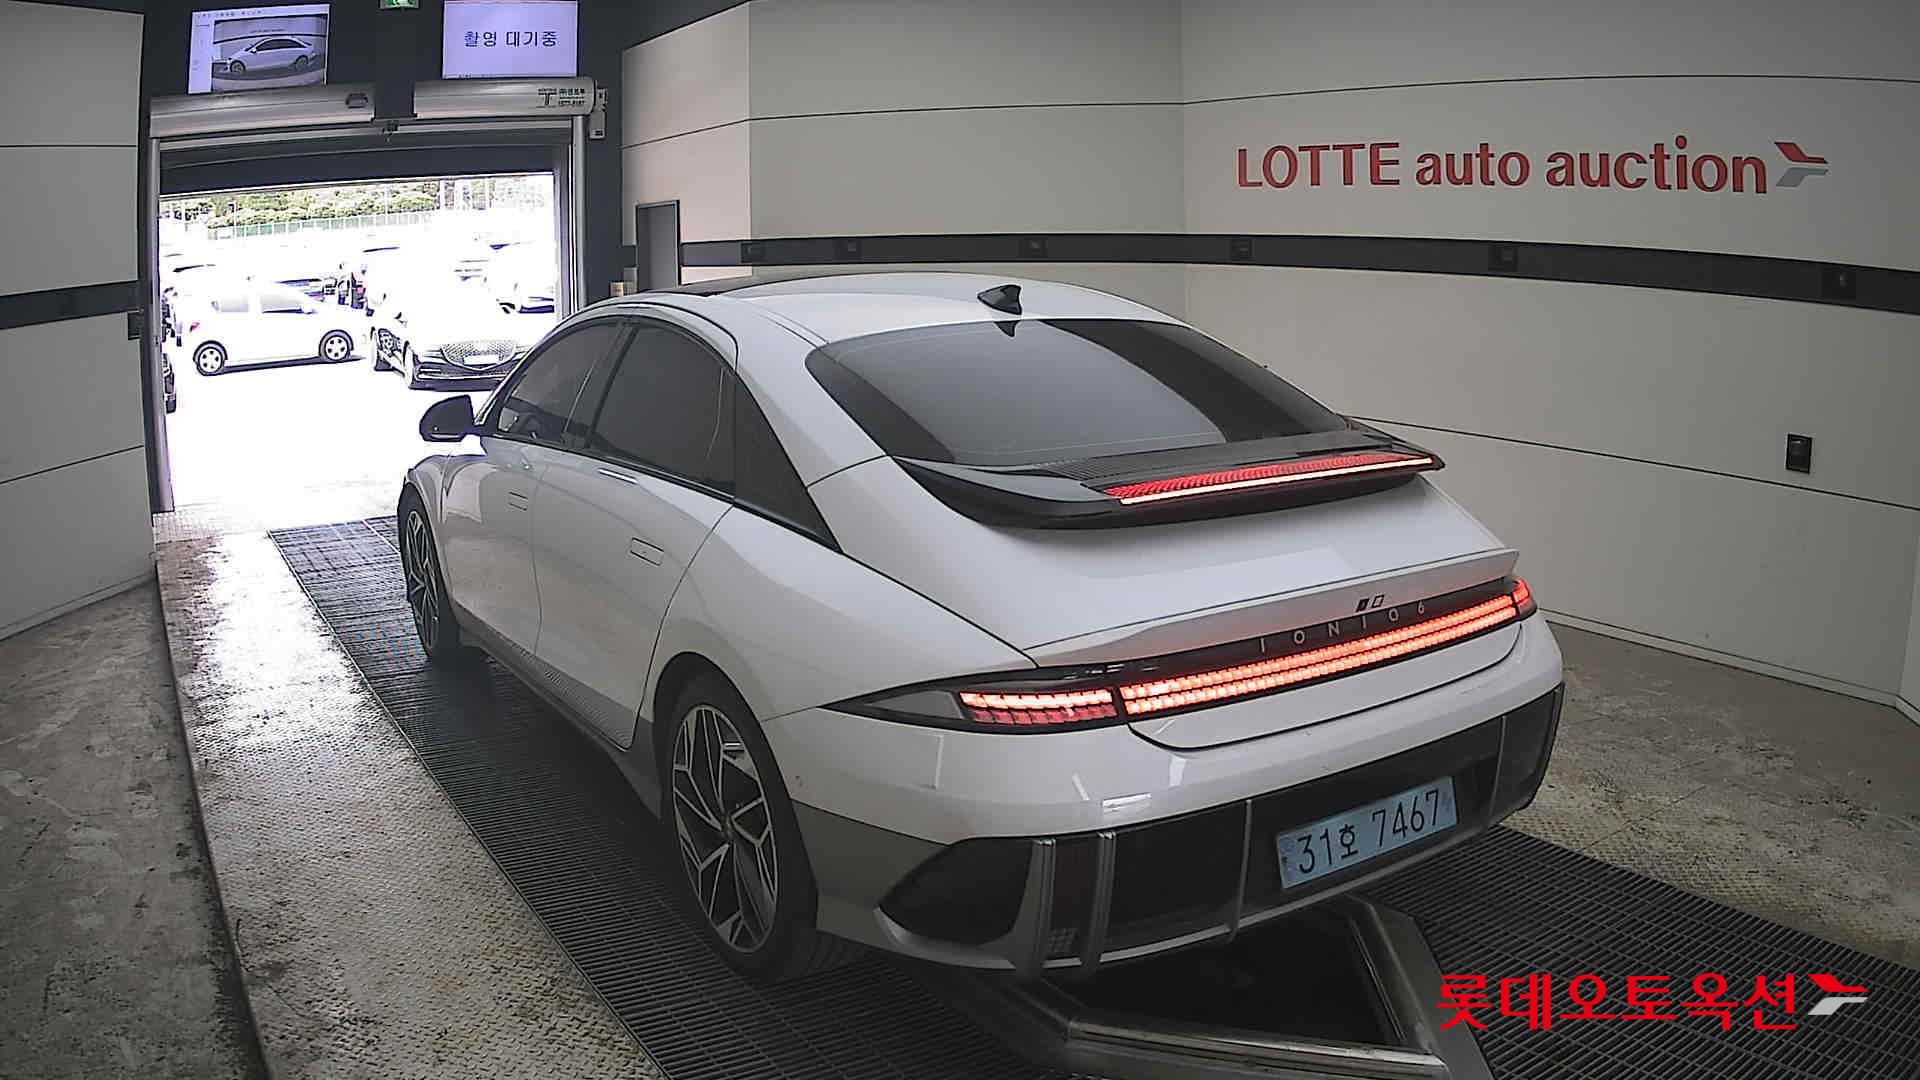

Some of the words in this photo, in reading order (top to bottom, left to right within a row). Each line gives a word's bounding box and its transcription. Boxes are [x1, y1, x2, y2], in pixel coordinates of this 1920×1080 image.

[464, 31, 497, 48] 촬영
[506, 31, 558, 48] 대기중
[1237, 142, 1400, 189] LOTTE
[1415, 142, 1532, 187] auto
[1545, 135, 1768, 194] auction
[1416, 600, 1426, 615] 6
[1297, 823, 1359, 874] 31호
[1371, 788, 1440, 847] 7467
